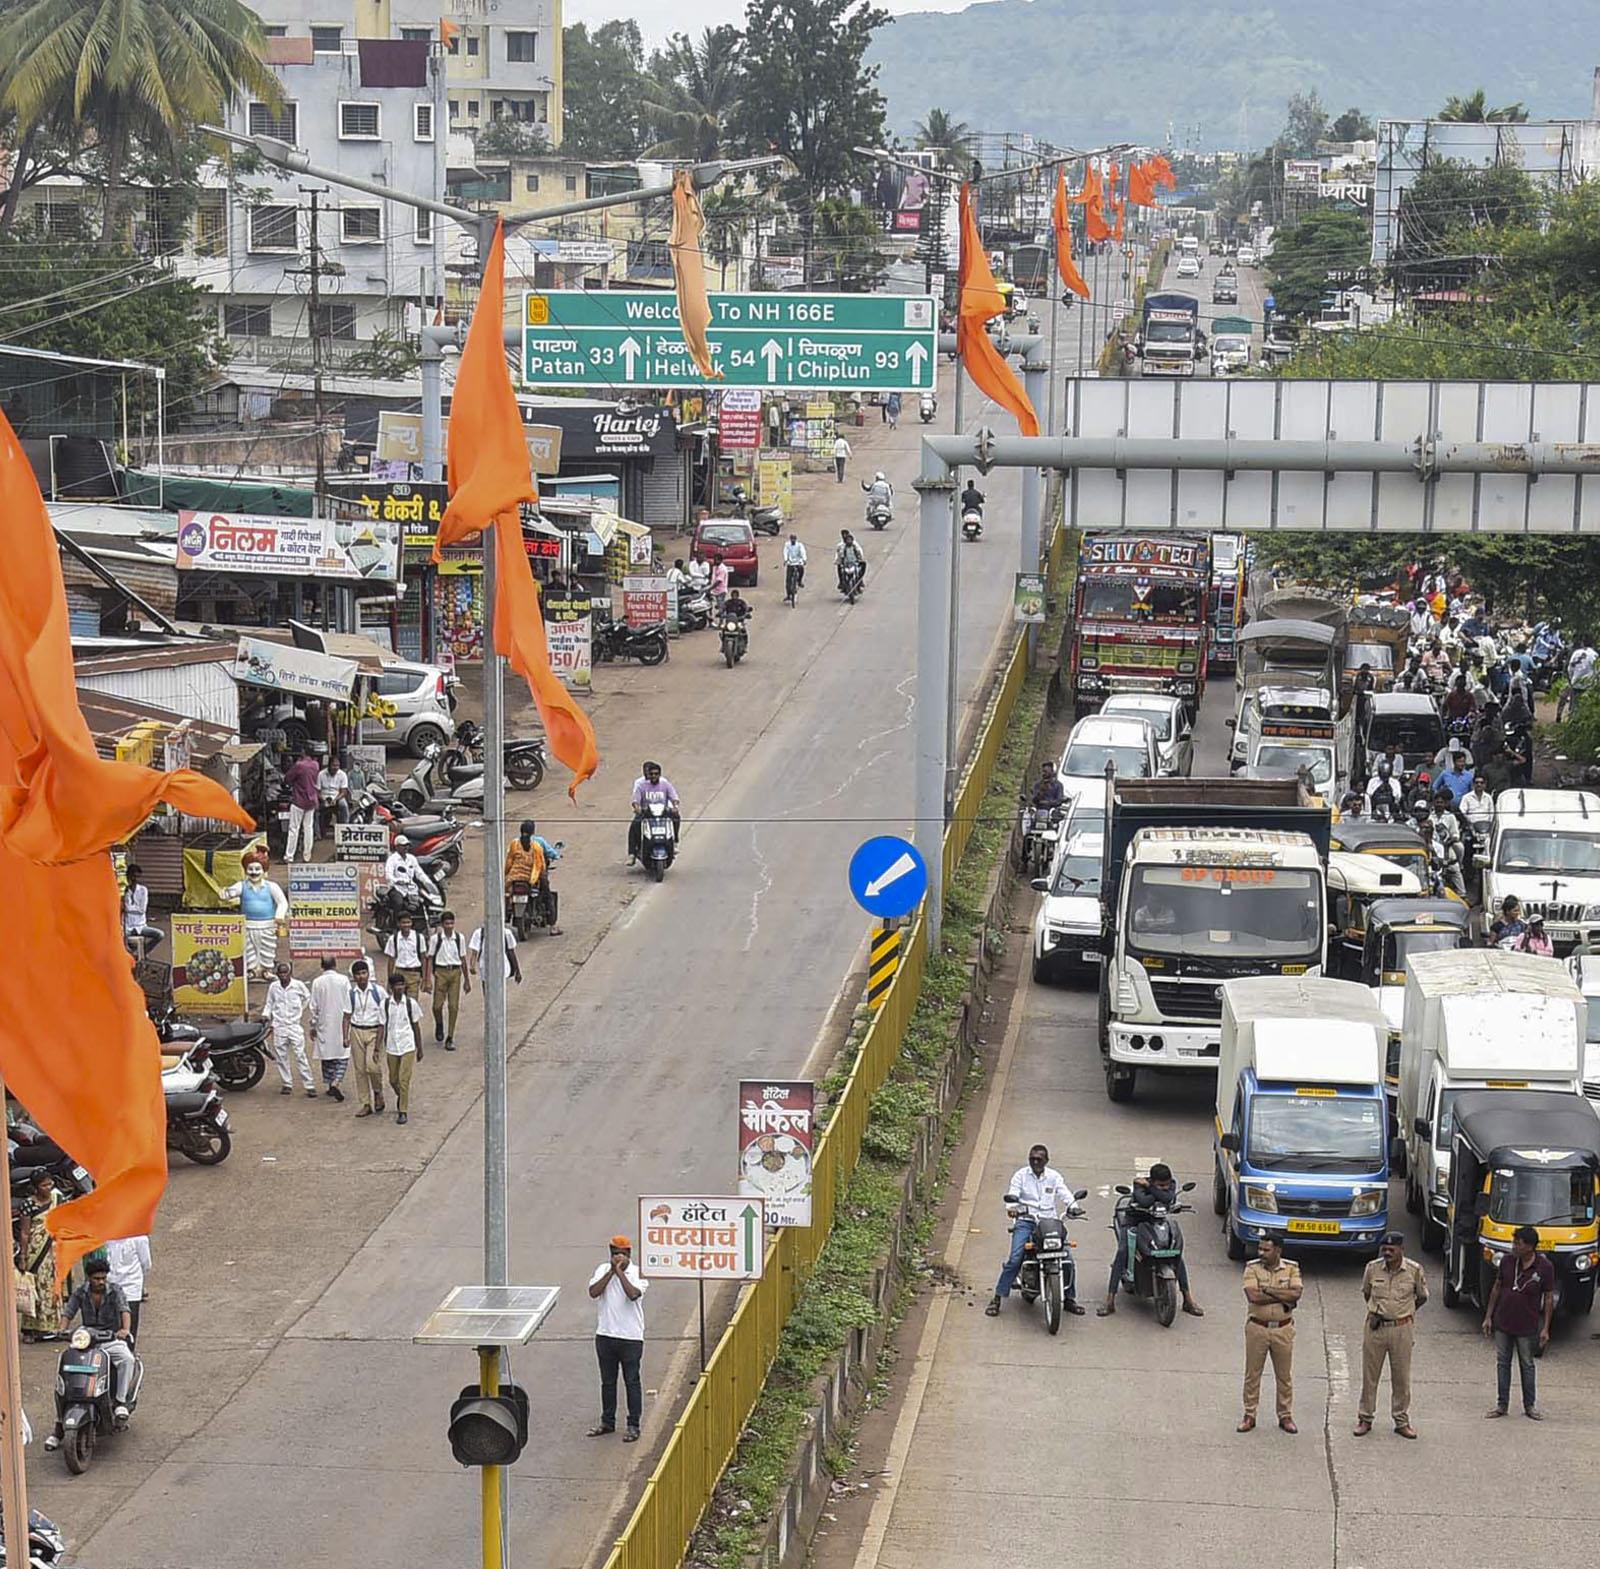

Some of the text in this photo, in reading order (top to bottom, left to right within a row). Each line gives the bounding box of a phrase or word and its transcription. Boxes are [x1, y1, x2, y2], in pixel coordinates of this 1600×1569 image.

[718, 302, 835, 321] To NH 166E
[532, 338, 577, 354] पाटण
[799, 339, 863, 361] चिपळूण
[532, 348, 614, 375] Patan 33
[730, 350, 756, 368] 54
[798, 351, 900, 381] Chiplun 93
[392, 484, 410, 496] SD
[383, 494, 424, 521] बेकरी
[429, 501, 441, 520] &
[209, 516, 279, 553] निलम
[1092, 544, 1194, 566] SHIV TEJ
[1181, 868, 1276, 884] SP GROUP
[326, 907, 358, 916] ZEROX
[681, 1203, 727, 1223] हॉटेल
[677, 1251, 739, 1272] मटण
